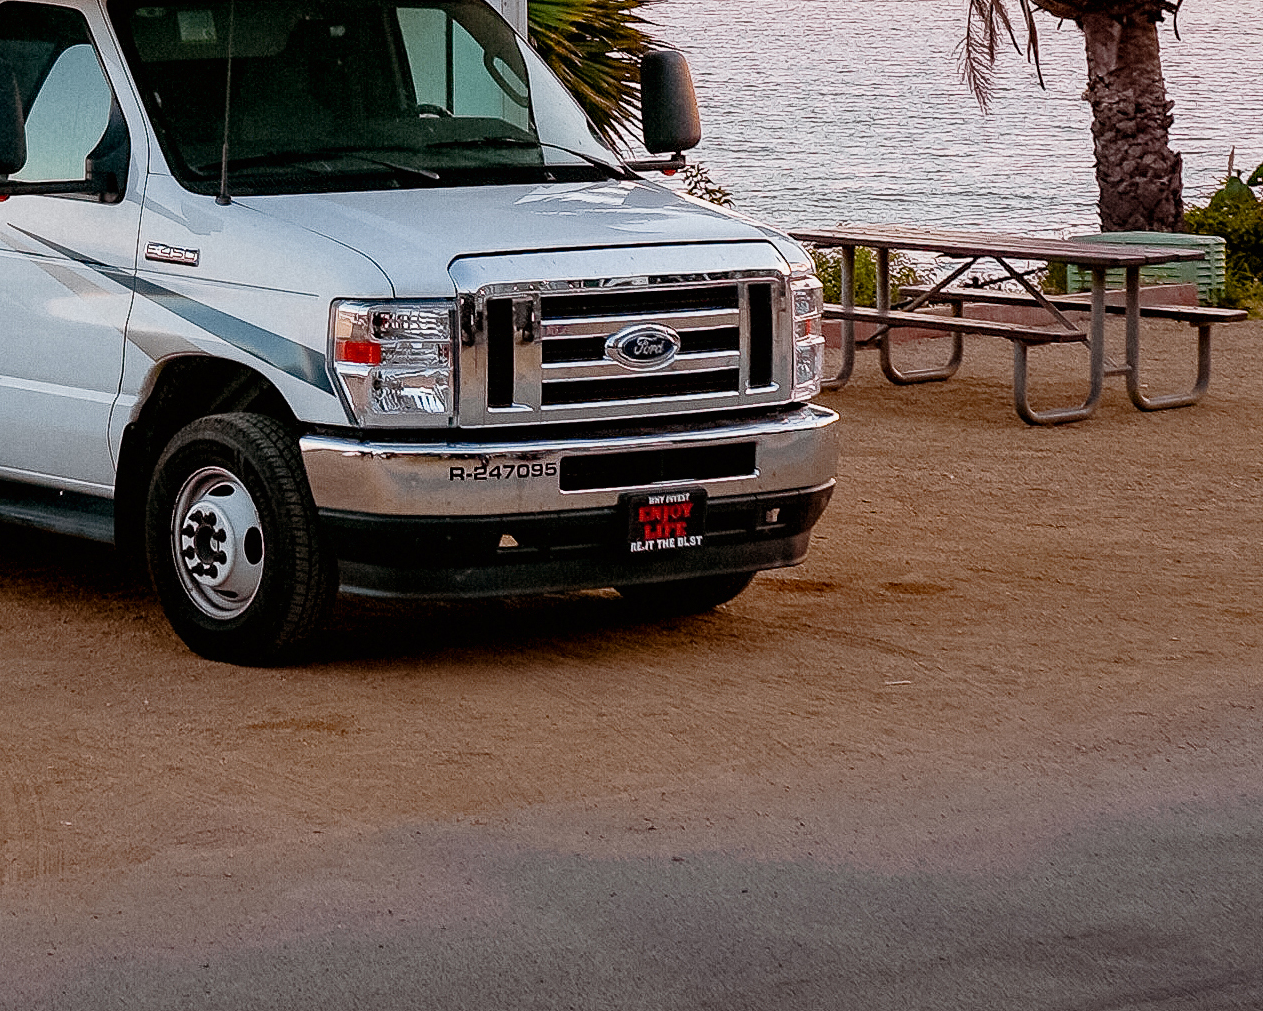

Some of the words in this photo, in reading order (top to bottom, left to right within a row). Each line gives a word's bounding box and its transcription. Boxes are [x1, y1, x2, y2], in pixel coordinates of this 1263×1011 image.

[634, 336, 666, 356] Ford
[449, 462, 558, 482] R-247095
[638, 501, 694, 523] ENJOY
[643, 520, 688, 541] LIFE
[656, 537, 676, 550] THE
